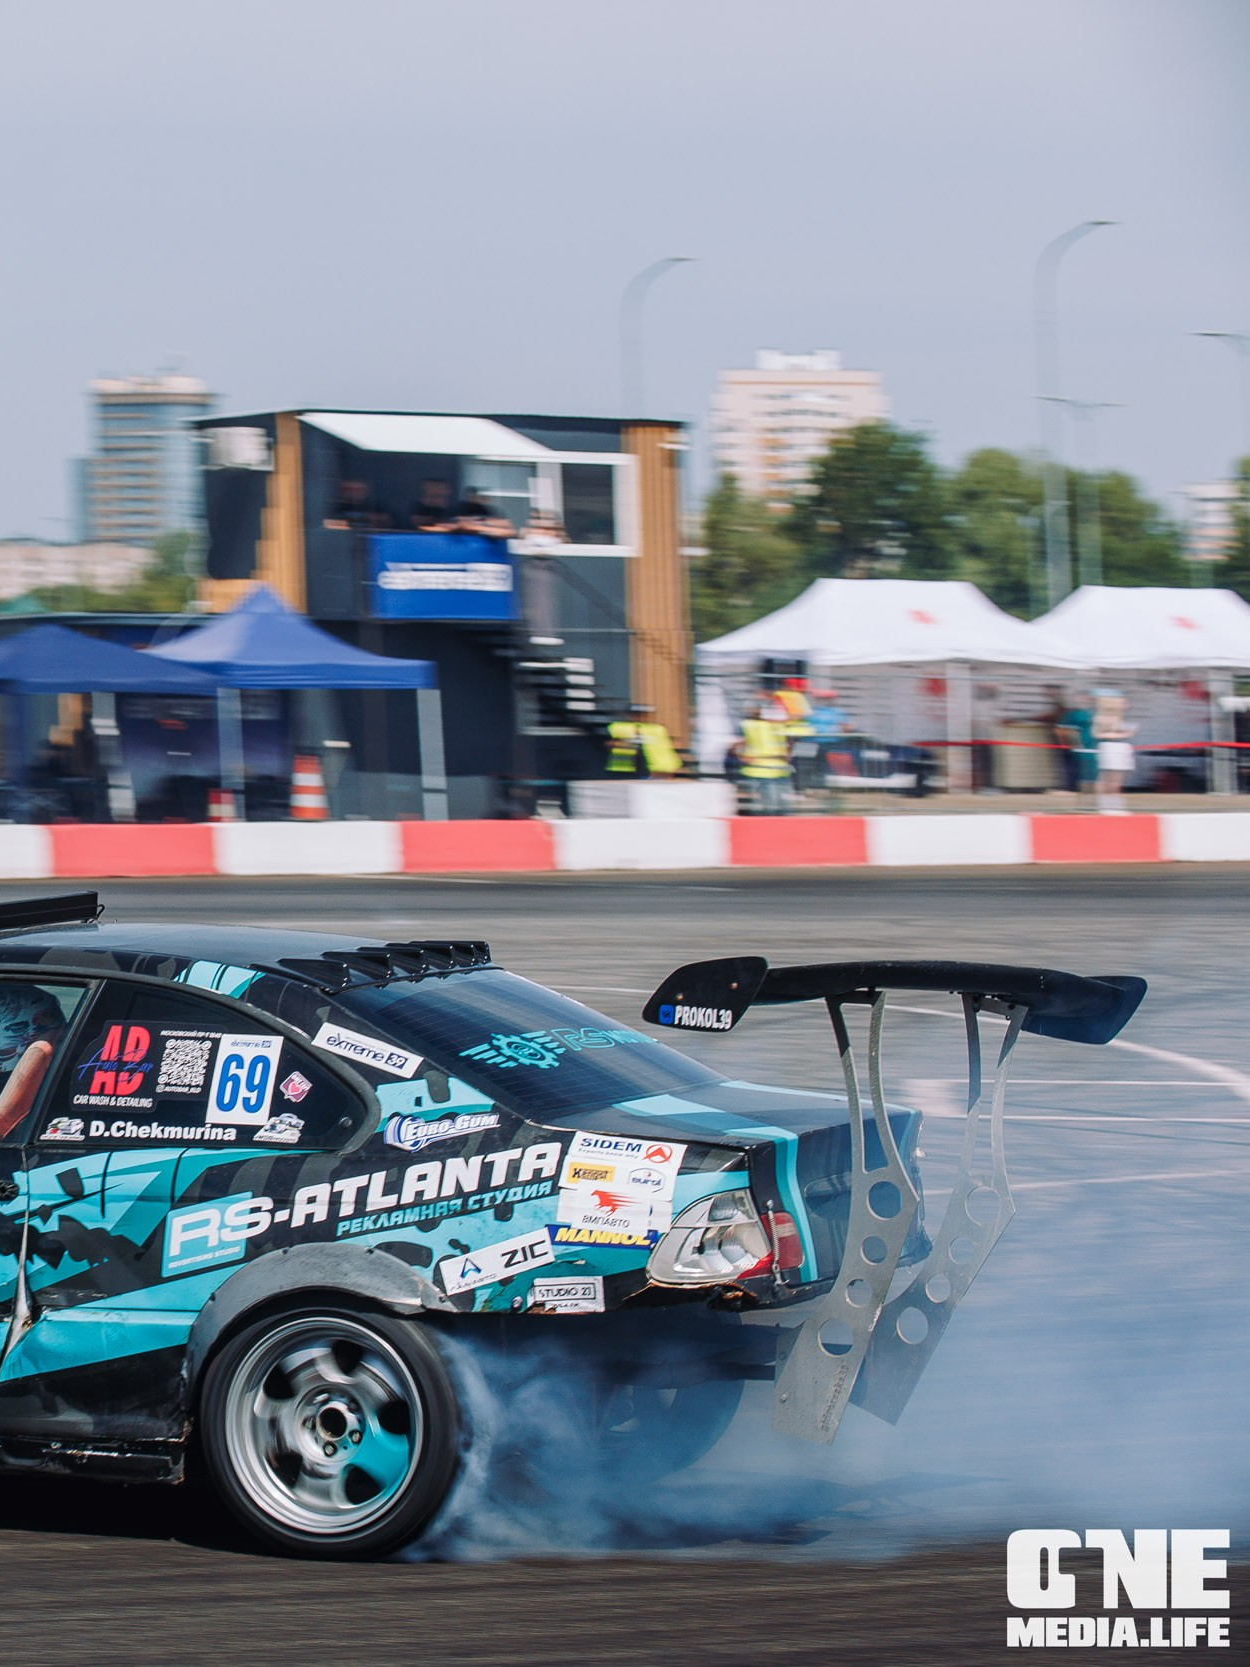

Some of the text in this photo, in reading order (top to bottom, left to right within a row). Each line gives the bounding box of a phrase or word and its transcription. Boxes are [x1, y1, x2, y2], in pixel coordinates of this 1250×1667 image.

[674, 1004, 732, 1030] PROKOL39
[216, 1053, 271, 1113] 69
[73, 1094, 153, 1109] CAR WASH & DETAILING
[89, 1120, 237, 1141] D.Chekmurina
[581, 1138, 643, 1153] SIDEM
[169, 1142, 562, 1257] RS-ATLANTA
[336, 1180, 554, 1237] РЕКЛАМНАЯ СТУДИЯ
[582, 1215, 630, 1229] ВМПАВТО
[554, 1227, 652, 1246] MANNOL
[501, 1240, 549, 1269] ZIC
[538, 1287, 579, 1298] STUDIO
